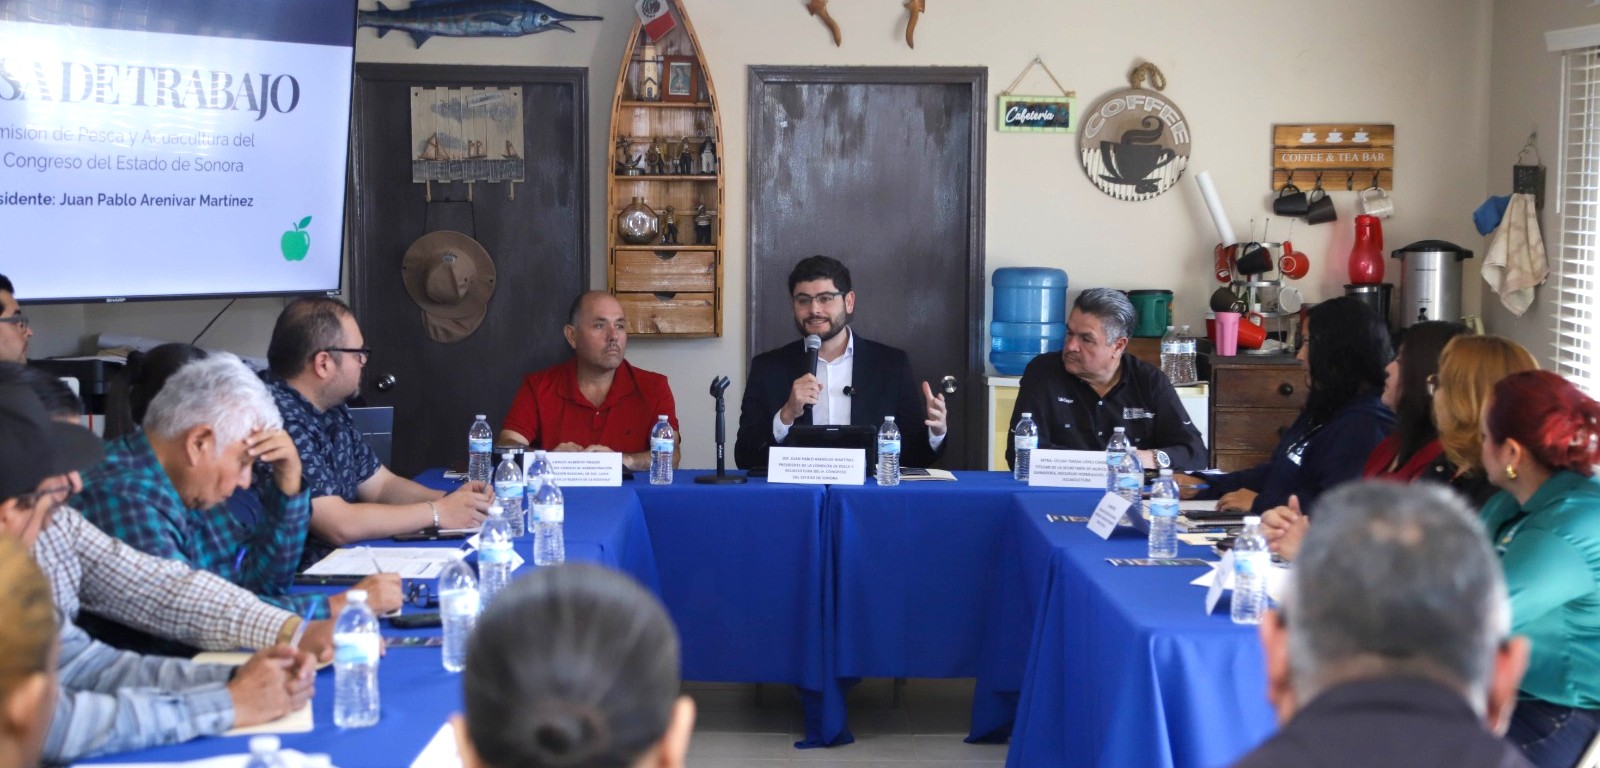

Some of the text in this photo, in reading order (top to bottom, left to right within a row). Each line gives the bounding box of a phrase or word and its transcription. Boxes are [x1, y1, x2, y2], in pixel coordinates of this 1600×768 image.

[60, 61, 120, 105] DE
[126, 65, 300, 121] TRABAJO
[1005, 106, 1055, 124] Cafeteria
[1084, 95, 1190, 145] COFFEE
[52, 125, 74, 141] de
[79, 126, 124, 143] Pesca
[129, 131, 138, 147] y
[142, 129, 229, 146] Acuacultura
[233, 132, 255, 147] del
[3, 151, 244, 172] Congreso del Estado de Sonora
[1282, 152, 1385, 162] COFFEE & TEA BAR
[59, 192, 94, 206] Juan
[97, 192, 137, 206] Pablo
[140, 193, 197, 207] Arenivar
[199, 194, 254, 207] Martínez
